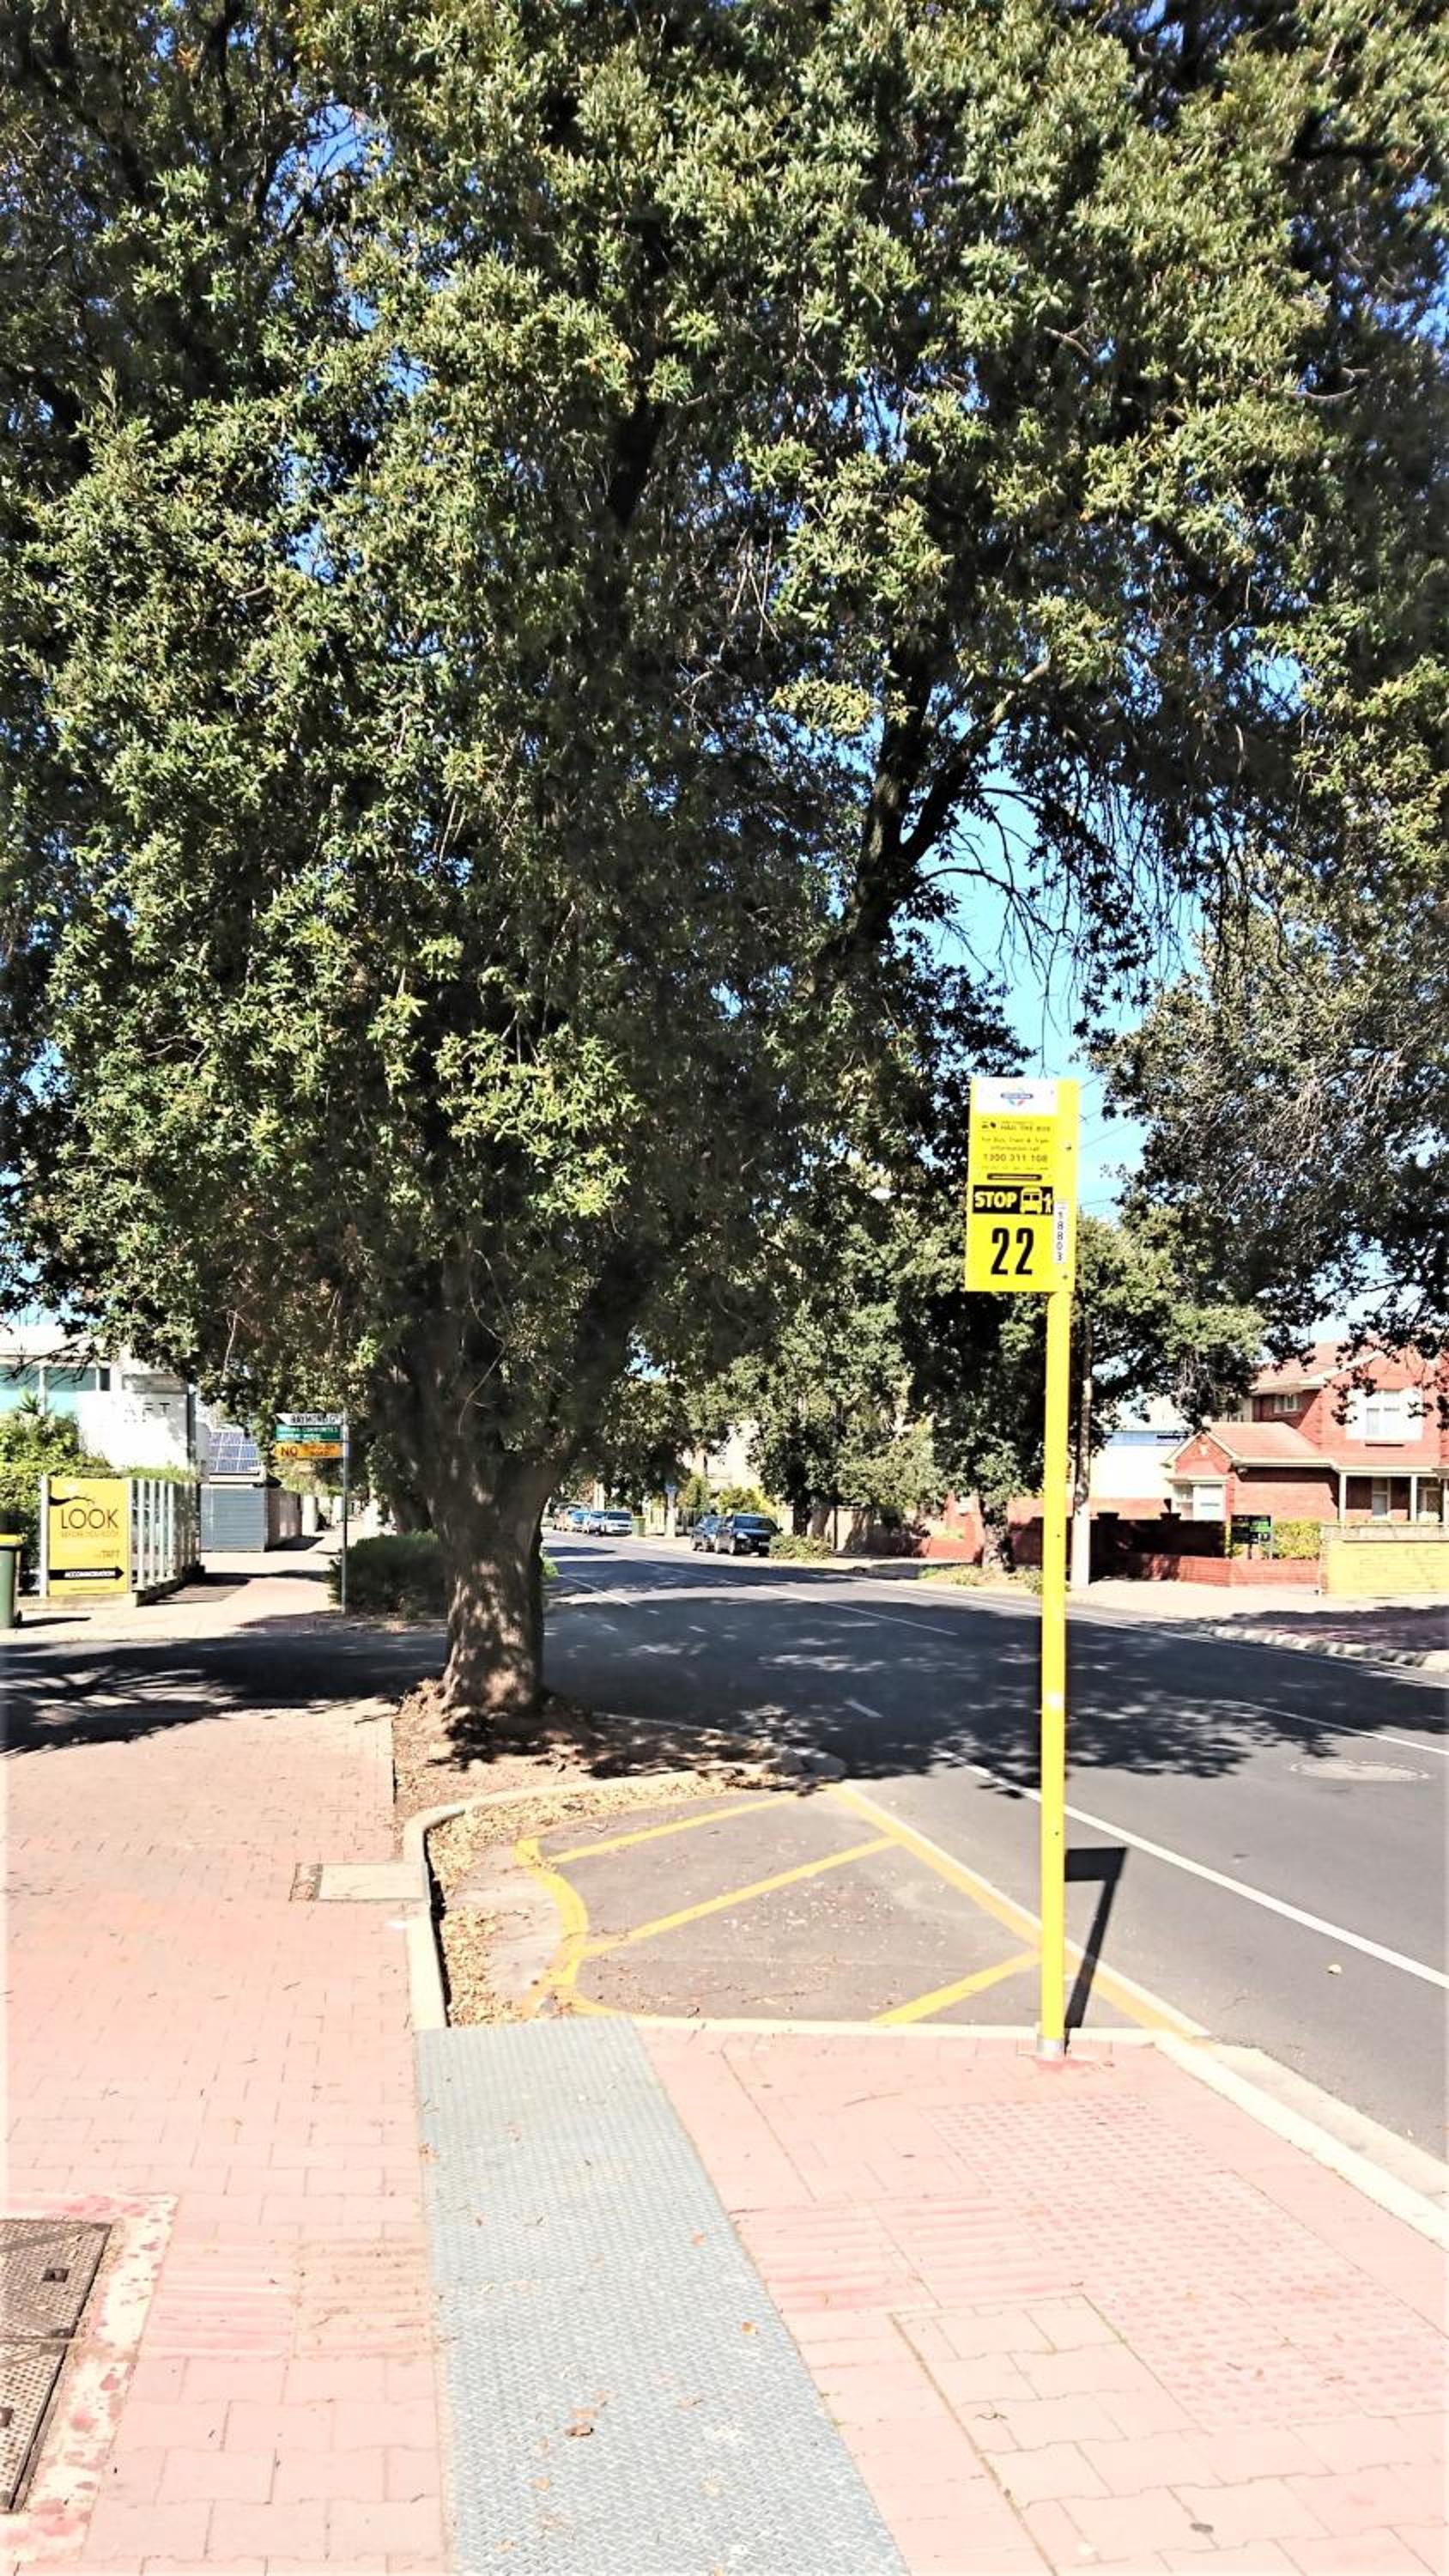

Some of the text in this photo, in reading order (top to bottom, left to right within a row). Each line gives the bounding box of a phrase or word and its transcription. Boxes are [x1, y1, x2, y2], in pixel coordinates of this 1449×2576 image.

[983, 1153, 1007, 1162] 1300
[1009, 1153, 1026, 1162] 311
[974, 1191, 1017, 1208] STOP
[991, 1228, 1034, 1275] 22
[281, 1446, 298, 1456] NO
[61, 1509, 118, 1529] LOOK
